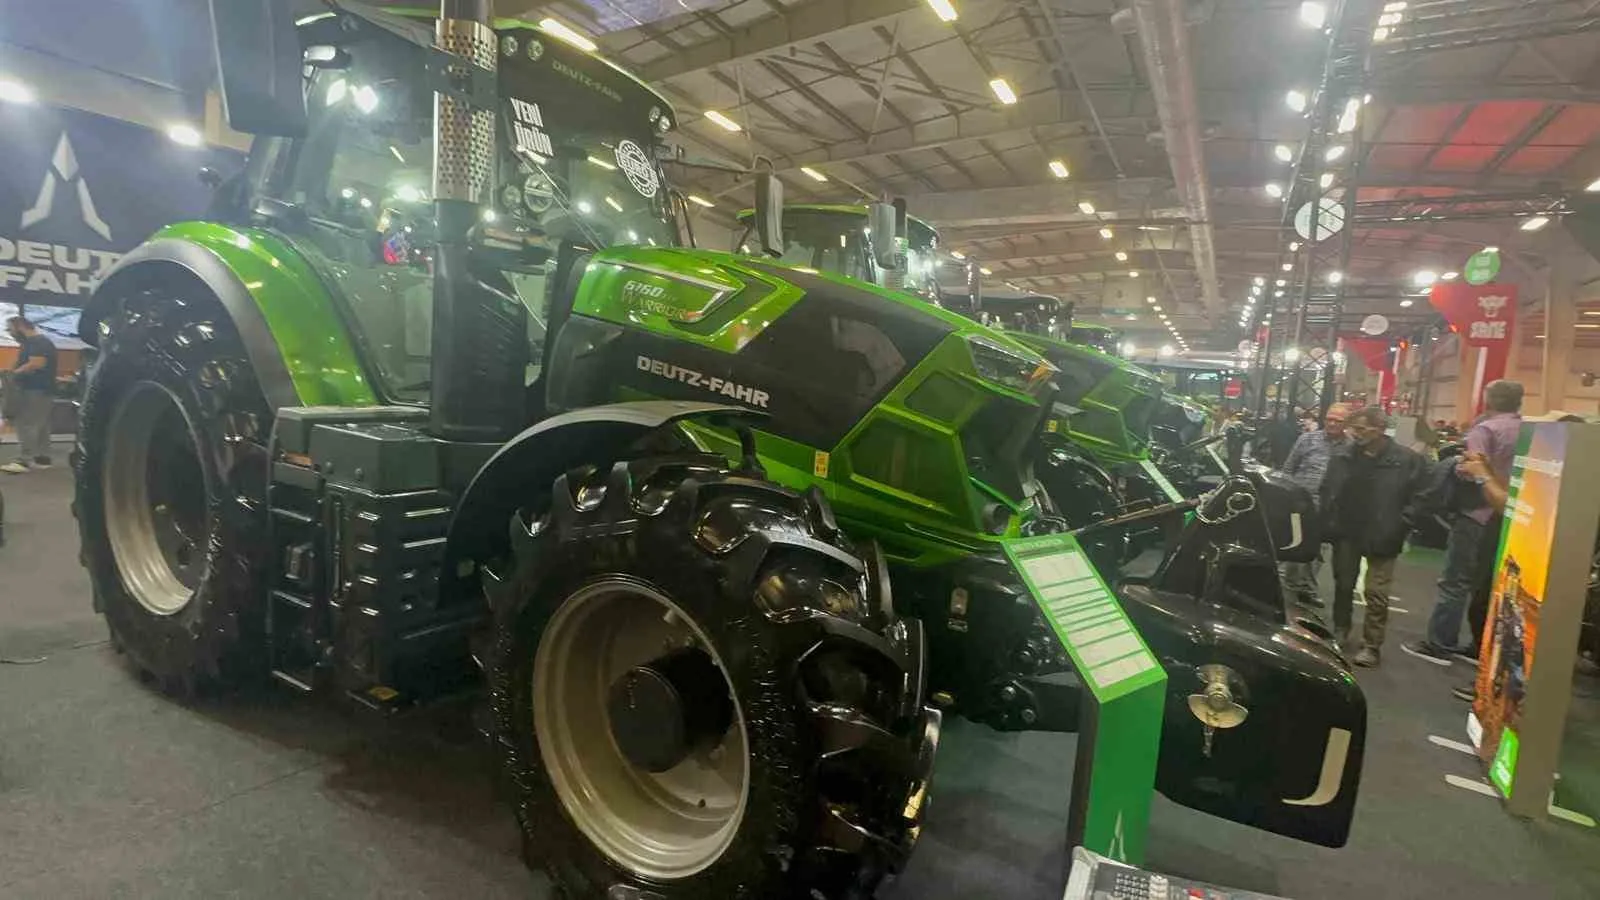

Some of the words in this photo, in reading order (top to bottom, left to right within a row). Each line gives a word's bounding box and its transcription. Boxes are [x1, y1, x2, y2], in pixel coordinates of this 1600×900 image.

[0, 236, 123, 273] DEUT
[0, 266, 98, 295] FAH
[624, 280, 664, 298] 6160
[637, 355, 770, 408] DEUTZ-FAHR
